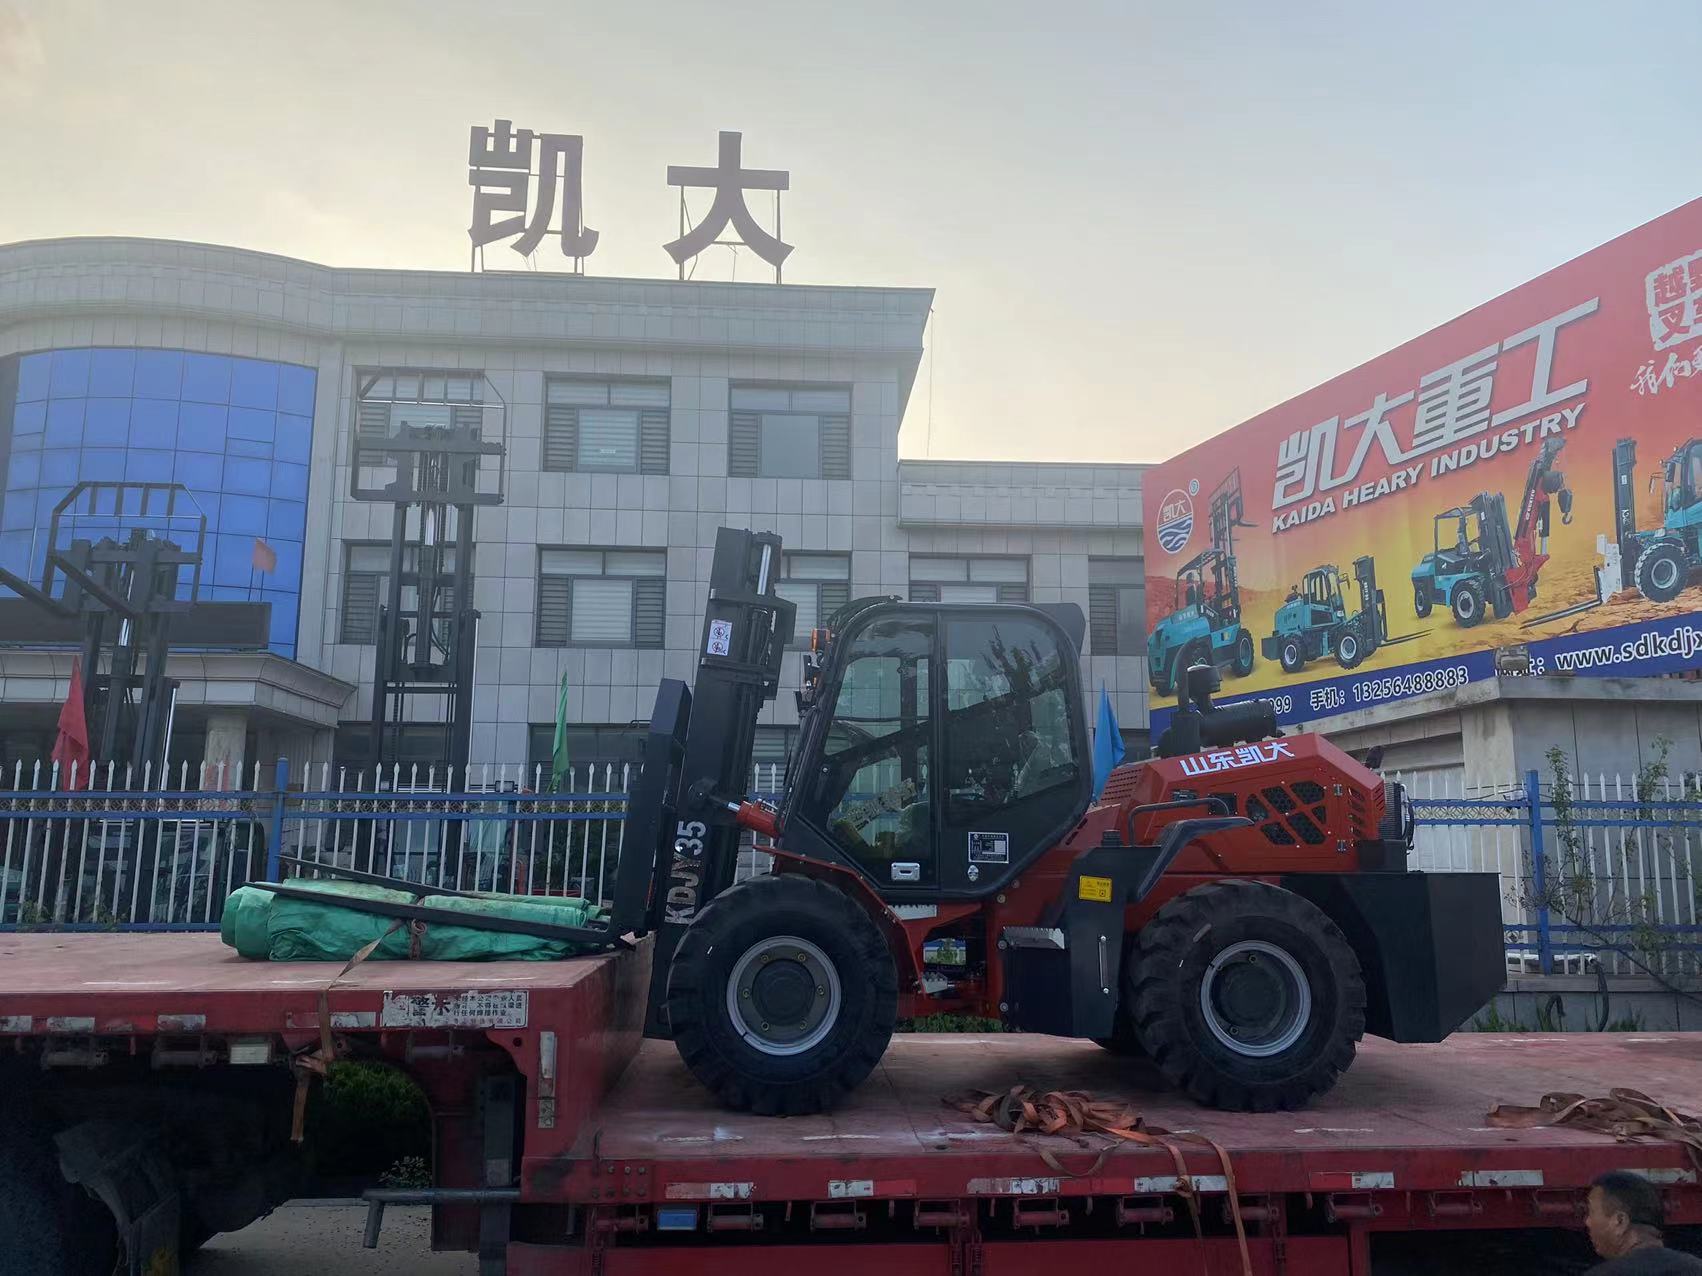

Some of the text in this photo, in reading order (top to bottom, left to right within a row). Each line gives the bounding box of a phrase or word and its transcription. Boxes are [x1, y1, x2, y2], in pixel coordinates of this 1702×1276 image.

[468, 119, 795, 267] 凯大
[1272, 296, 1599, 510] 凯大重工
[1162, 499, 1187, 522] 凯大
[1272, 402, 1586, 534] KAIDA HEARY INDUSTRY
[1352, 665, 1469, 703] 13256488883
[1179, 741, 1295, 776] 山东凯大
